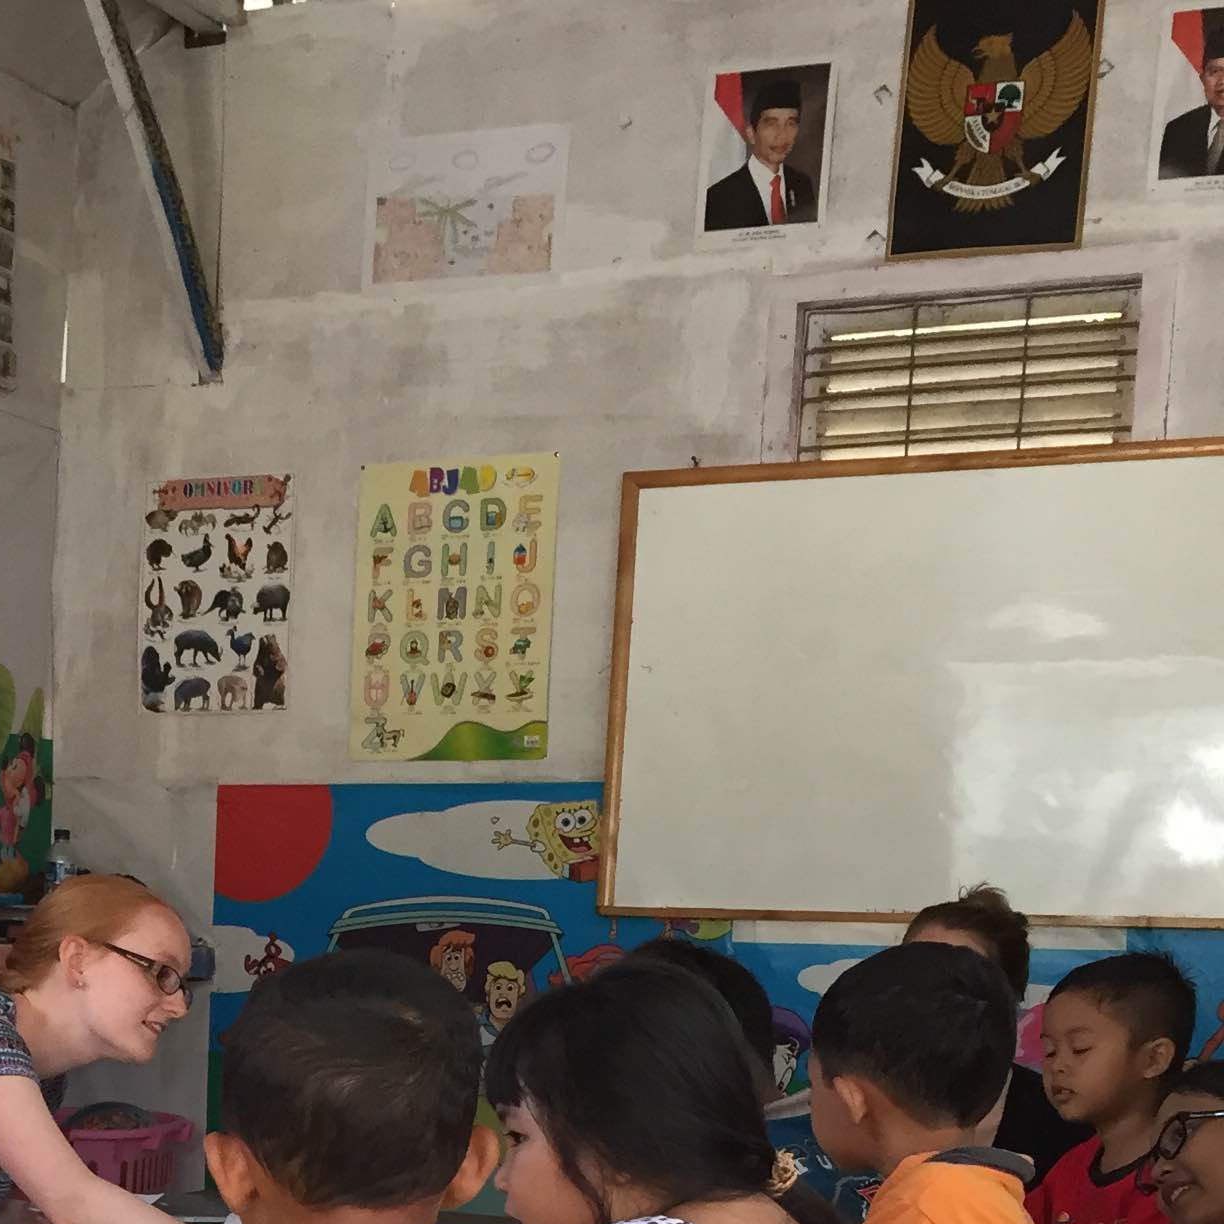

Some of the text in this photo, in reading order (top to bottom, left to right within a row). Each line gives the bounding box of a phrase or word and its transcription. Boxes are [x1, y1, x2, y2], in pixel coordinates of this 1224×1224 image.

[409, 465, 497, 497] ABJAD
[370, 503, 397, 538] A
[408, 502, 432, 535] B
[480, 497, 507, 531] D
[403, 544, 432, 578] G
[441, 542, 468, 577] H
[368, 589, 393, 622] K
[437, 586, 467, 620] M
[473, 584, 502, 618] N
[510, 583, 541, 618] O
[400, 630, 430, 666] Q
[438, 630, 463, 663] R
[474, 628, 499, 663] S
